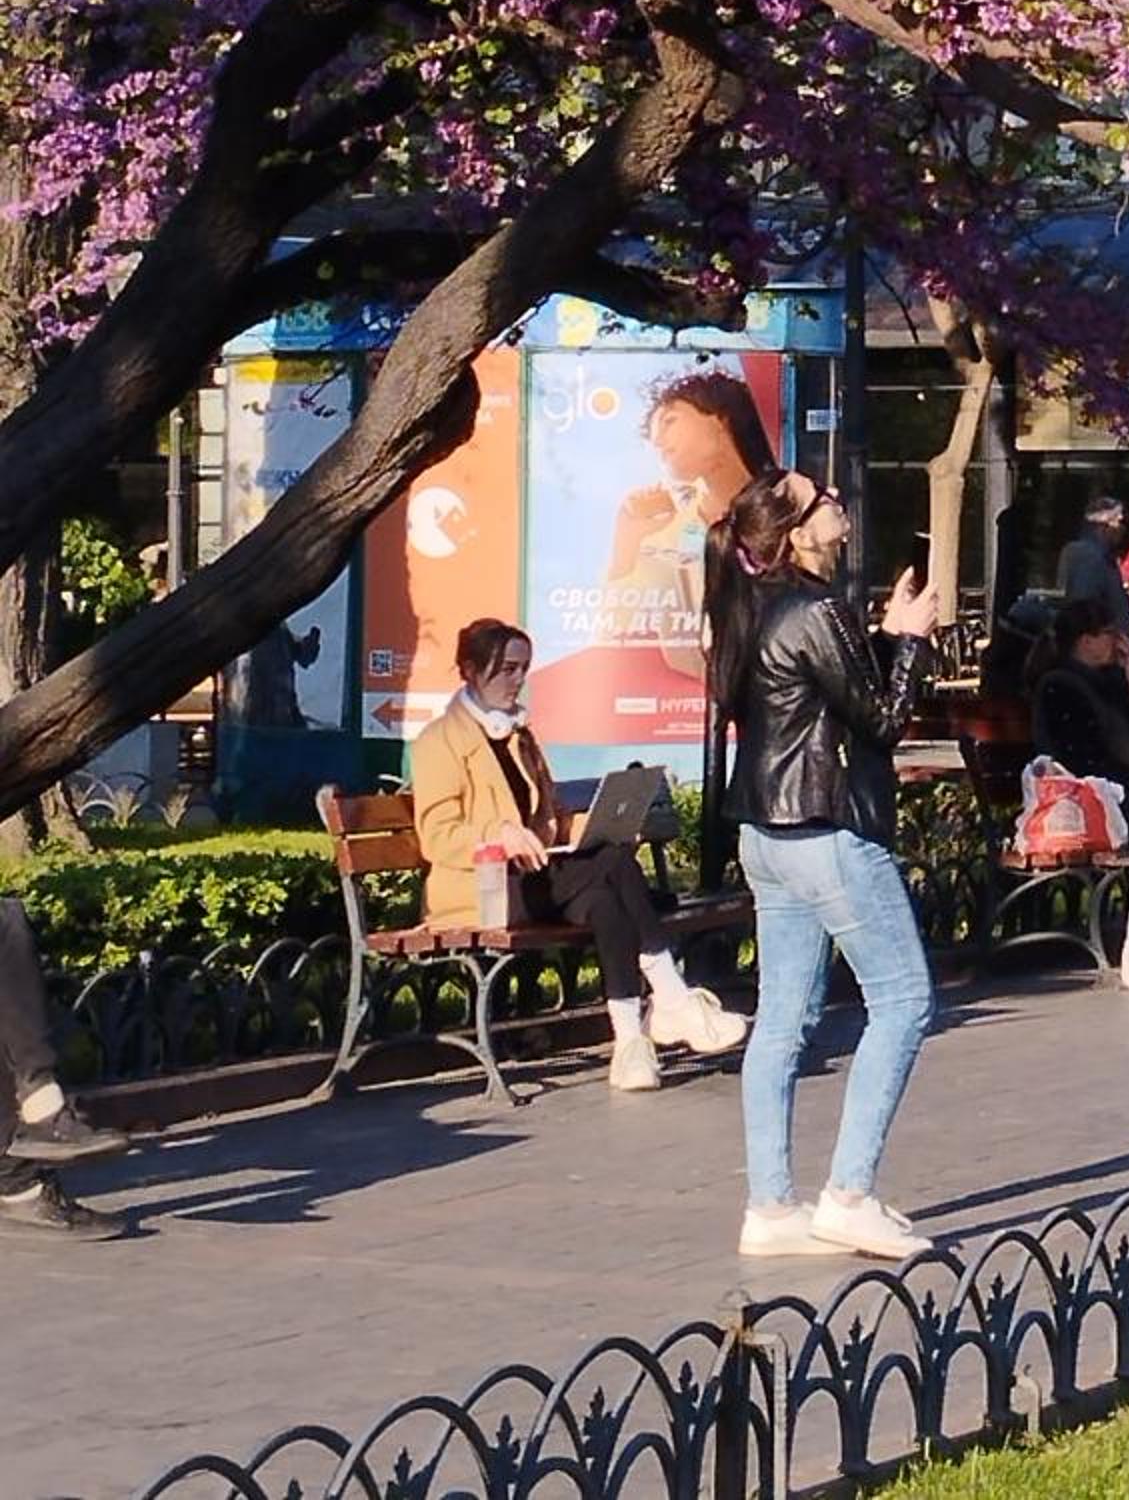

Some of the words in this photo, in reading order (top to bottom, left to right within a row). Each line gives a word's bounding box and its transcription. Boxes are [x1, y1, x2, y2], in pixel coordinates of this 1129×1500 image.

[543, 364, 621, 434] glo
[549, 587, 680, 610] СВОБОДА
[630, 610, 663, 634] ДЕ
